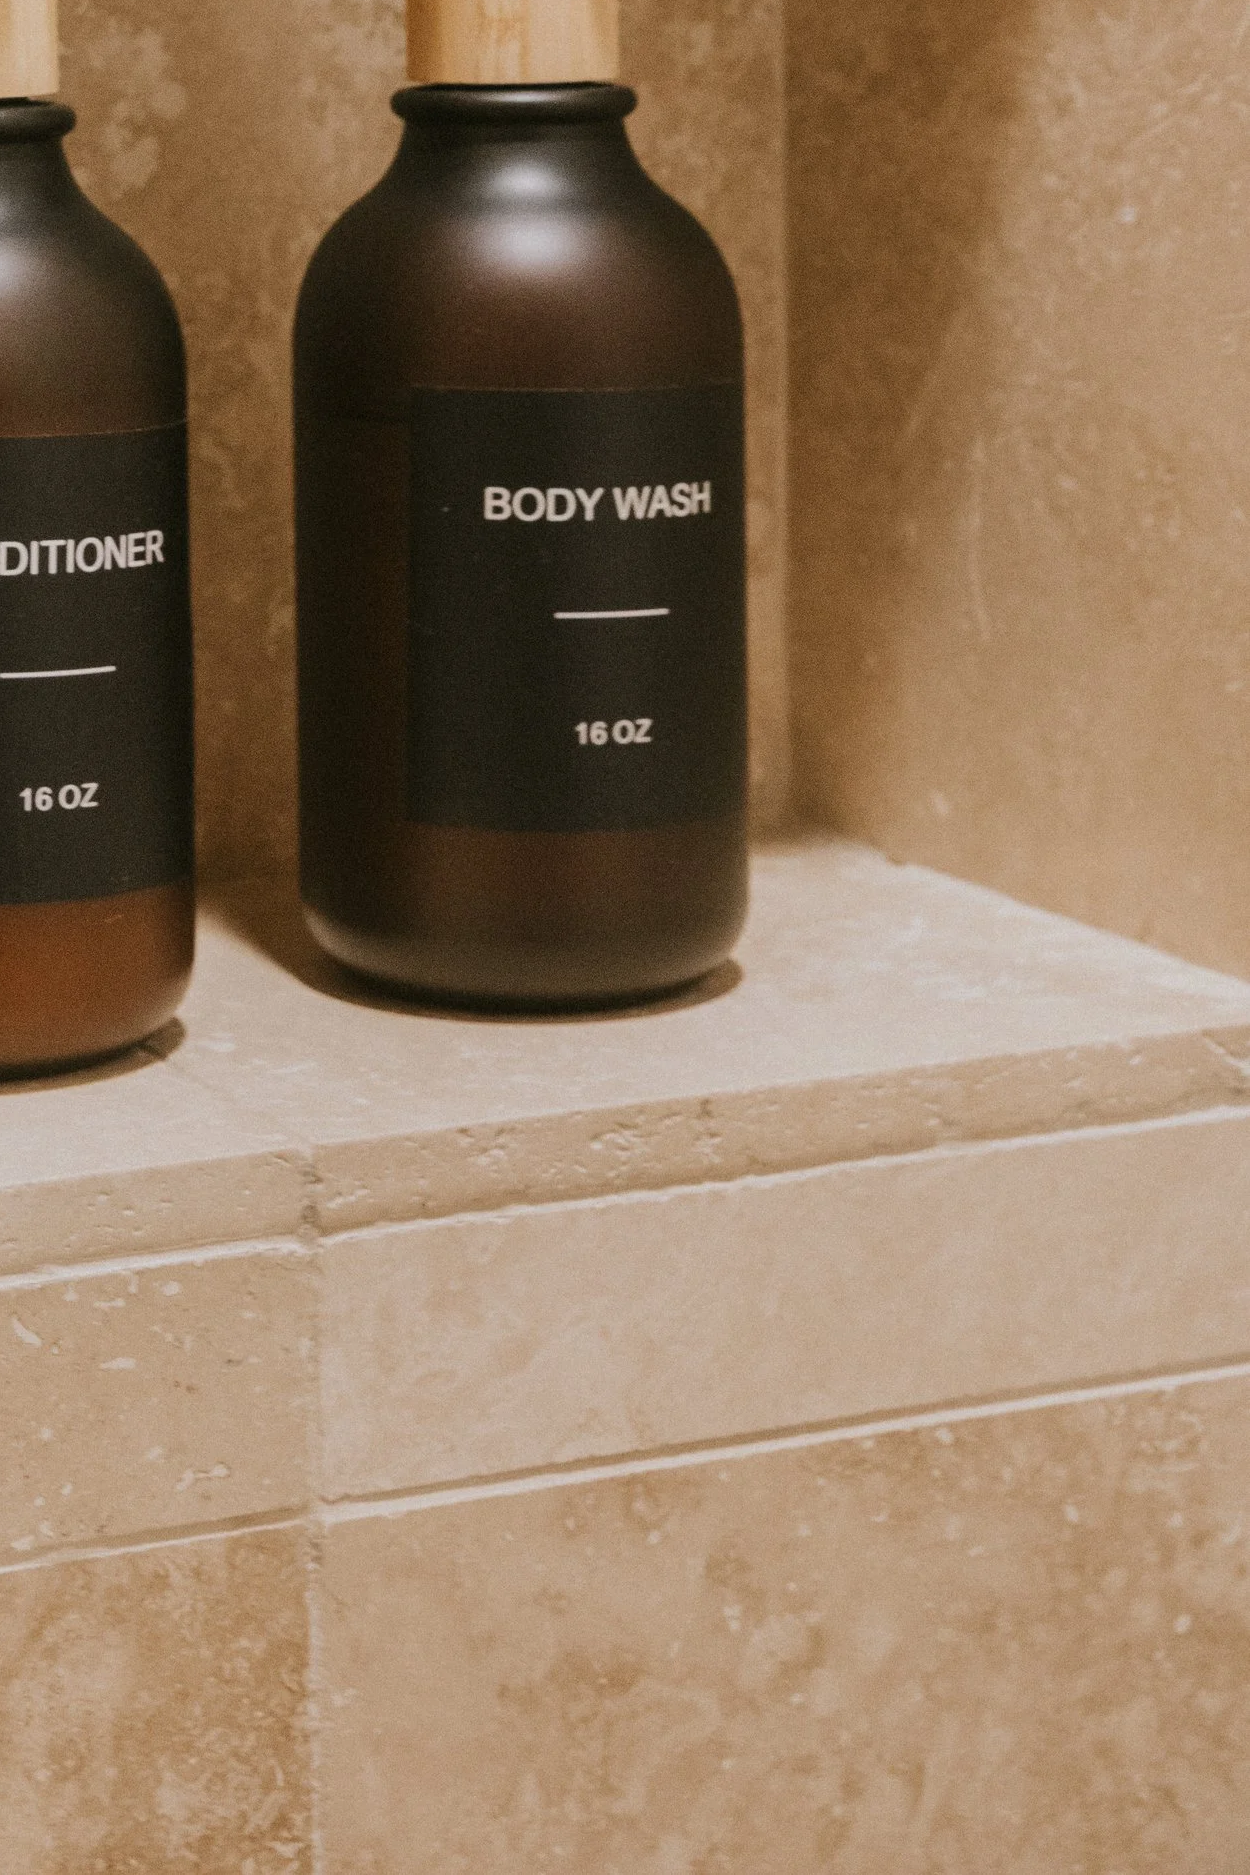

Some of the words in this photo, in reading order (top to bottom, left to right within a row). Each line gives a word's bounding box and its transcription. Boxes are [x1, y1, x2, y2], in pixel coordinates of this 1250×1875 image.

[483, 486, 603, 522] BODY
[612, 481, 712, 521] WASH
[575, 721, 609, 746] 16
[612, 718, 653, 745] OZ
[19, 786, 54, 812] 16
[58, 782, 100, 810] OZ
